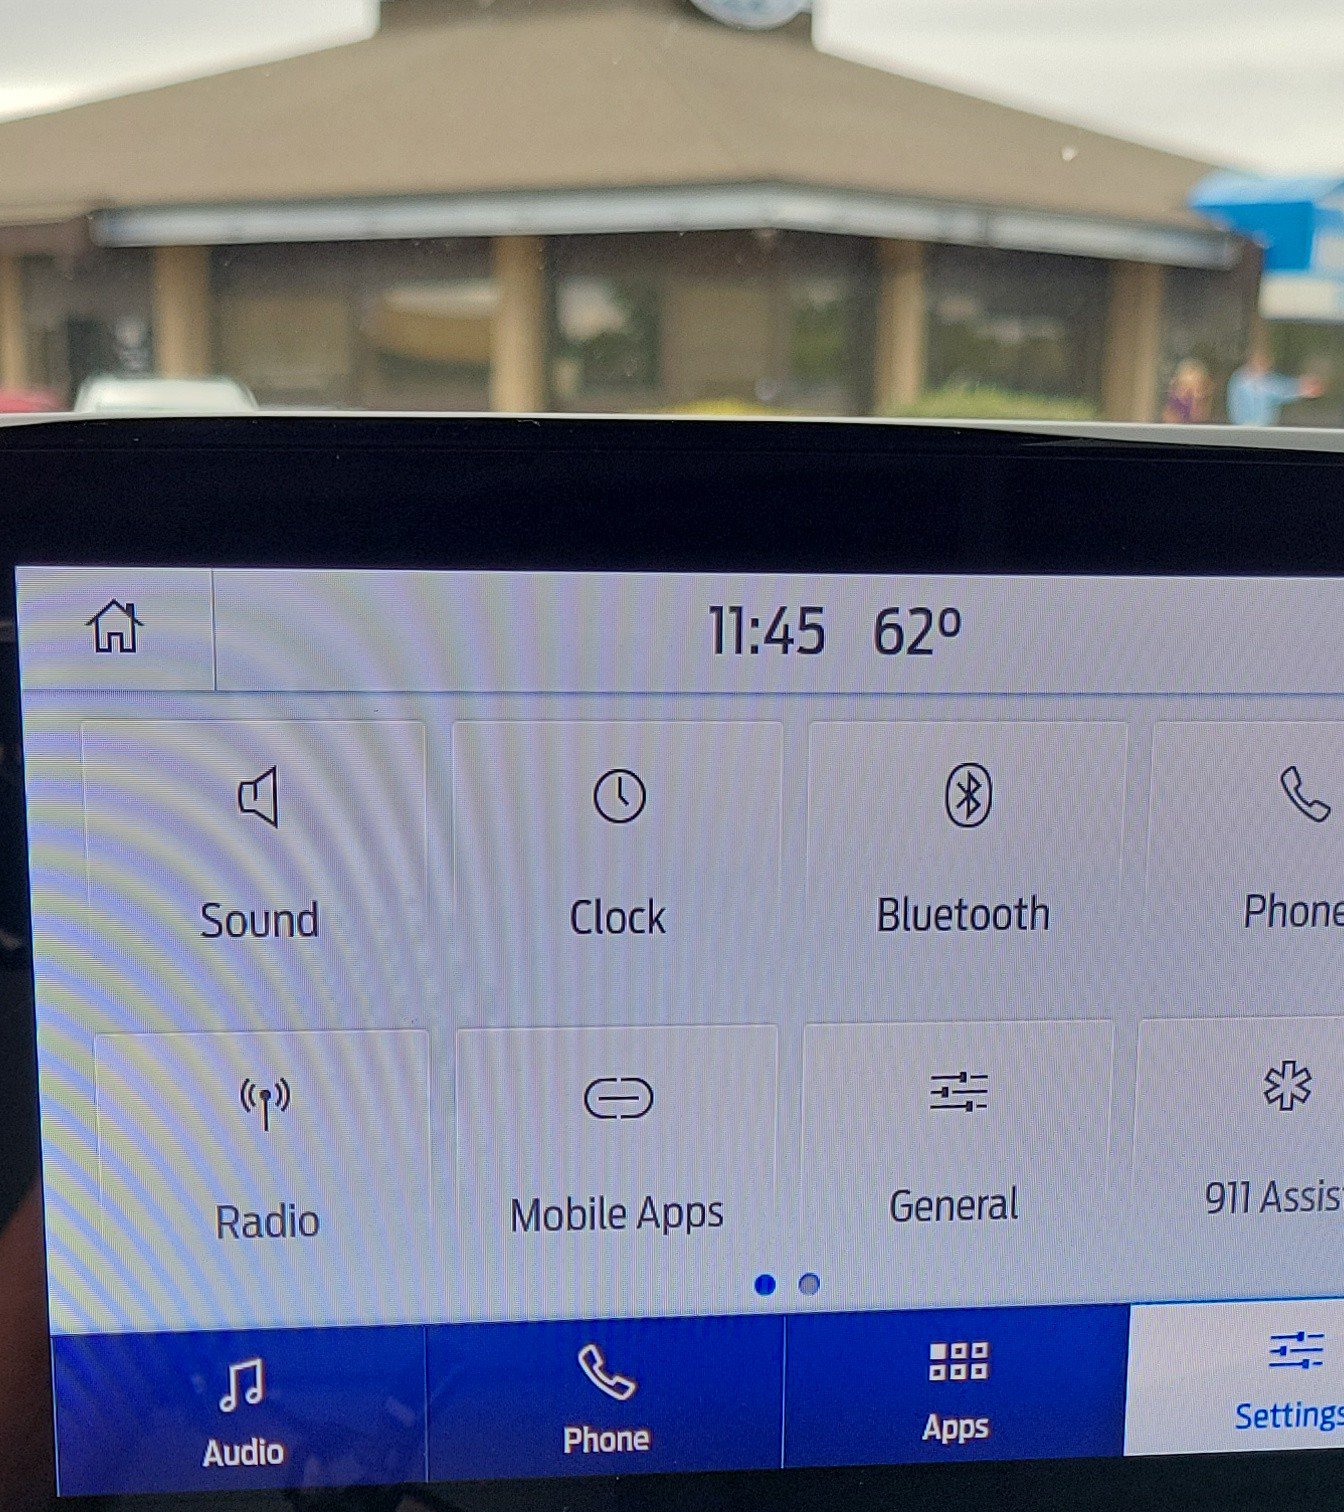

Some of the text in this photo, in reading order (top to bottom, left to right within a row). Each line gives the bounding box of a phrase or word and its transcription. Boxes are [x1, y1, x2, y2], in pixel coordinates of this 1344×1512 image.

[709, 605, 826, 656] 11:45
[200, 900, 319, 938] Sound
[570, 898, 666, 935] Clock
[877, 895, 1050, 933] Bluetooth
[510, 1195, 725, 1235] Mobile Apps
[889, 1185, 1019, 1223] General
[1204, 1180, 1251, 1214] 911
[215, 1202, 321, 1240] Radio
[563, 1425, 650, 1455] Phone
[921, 1413, 990, 1445] Apps
[202, 1438, 285, 1468] Audio
